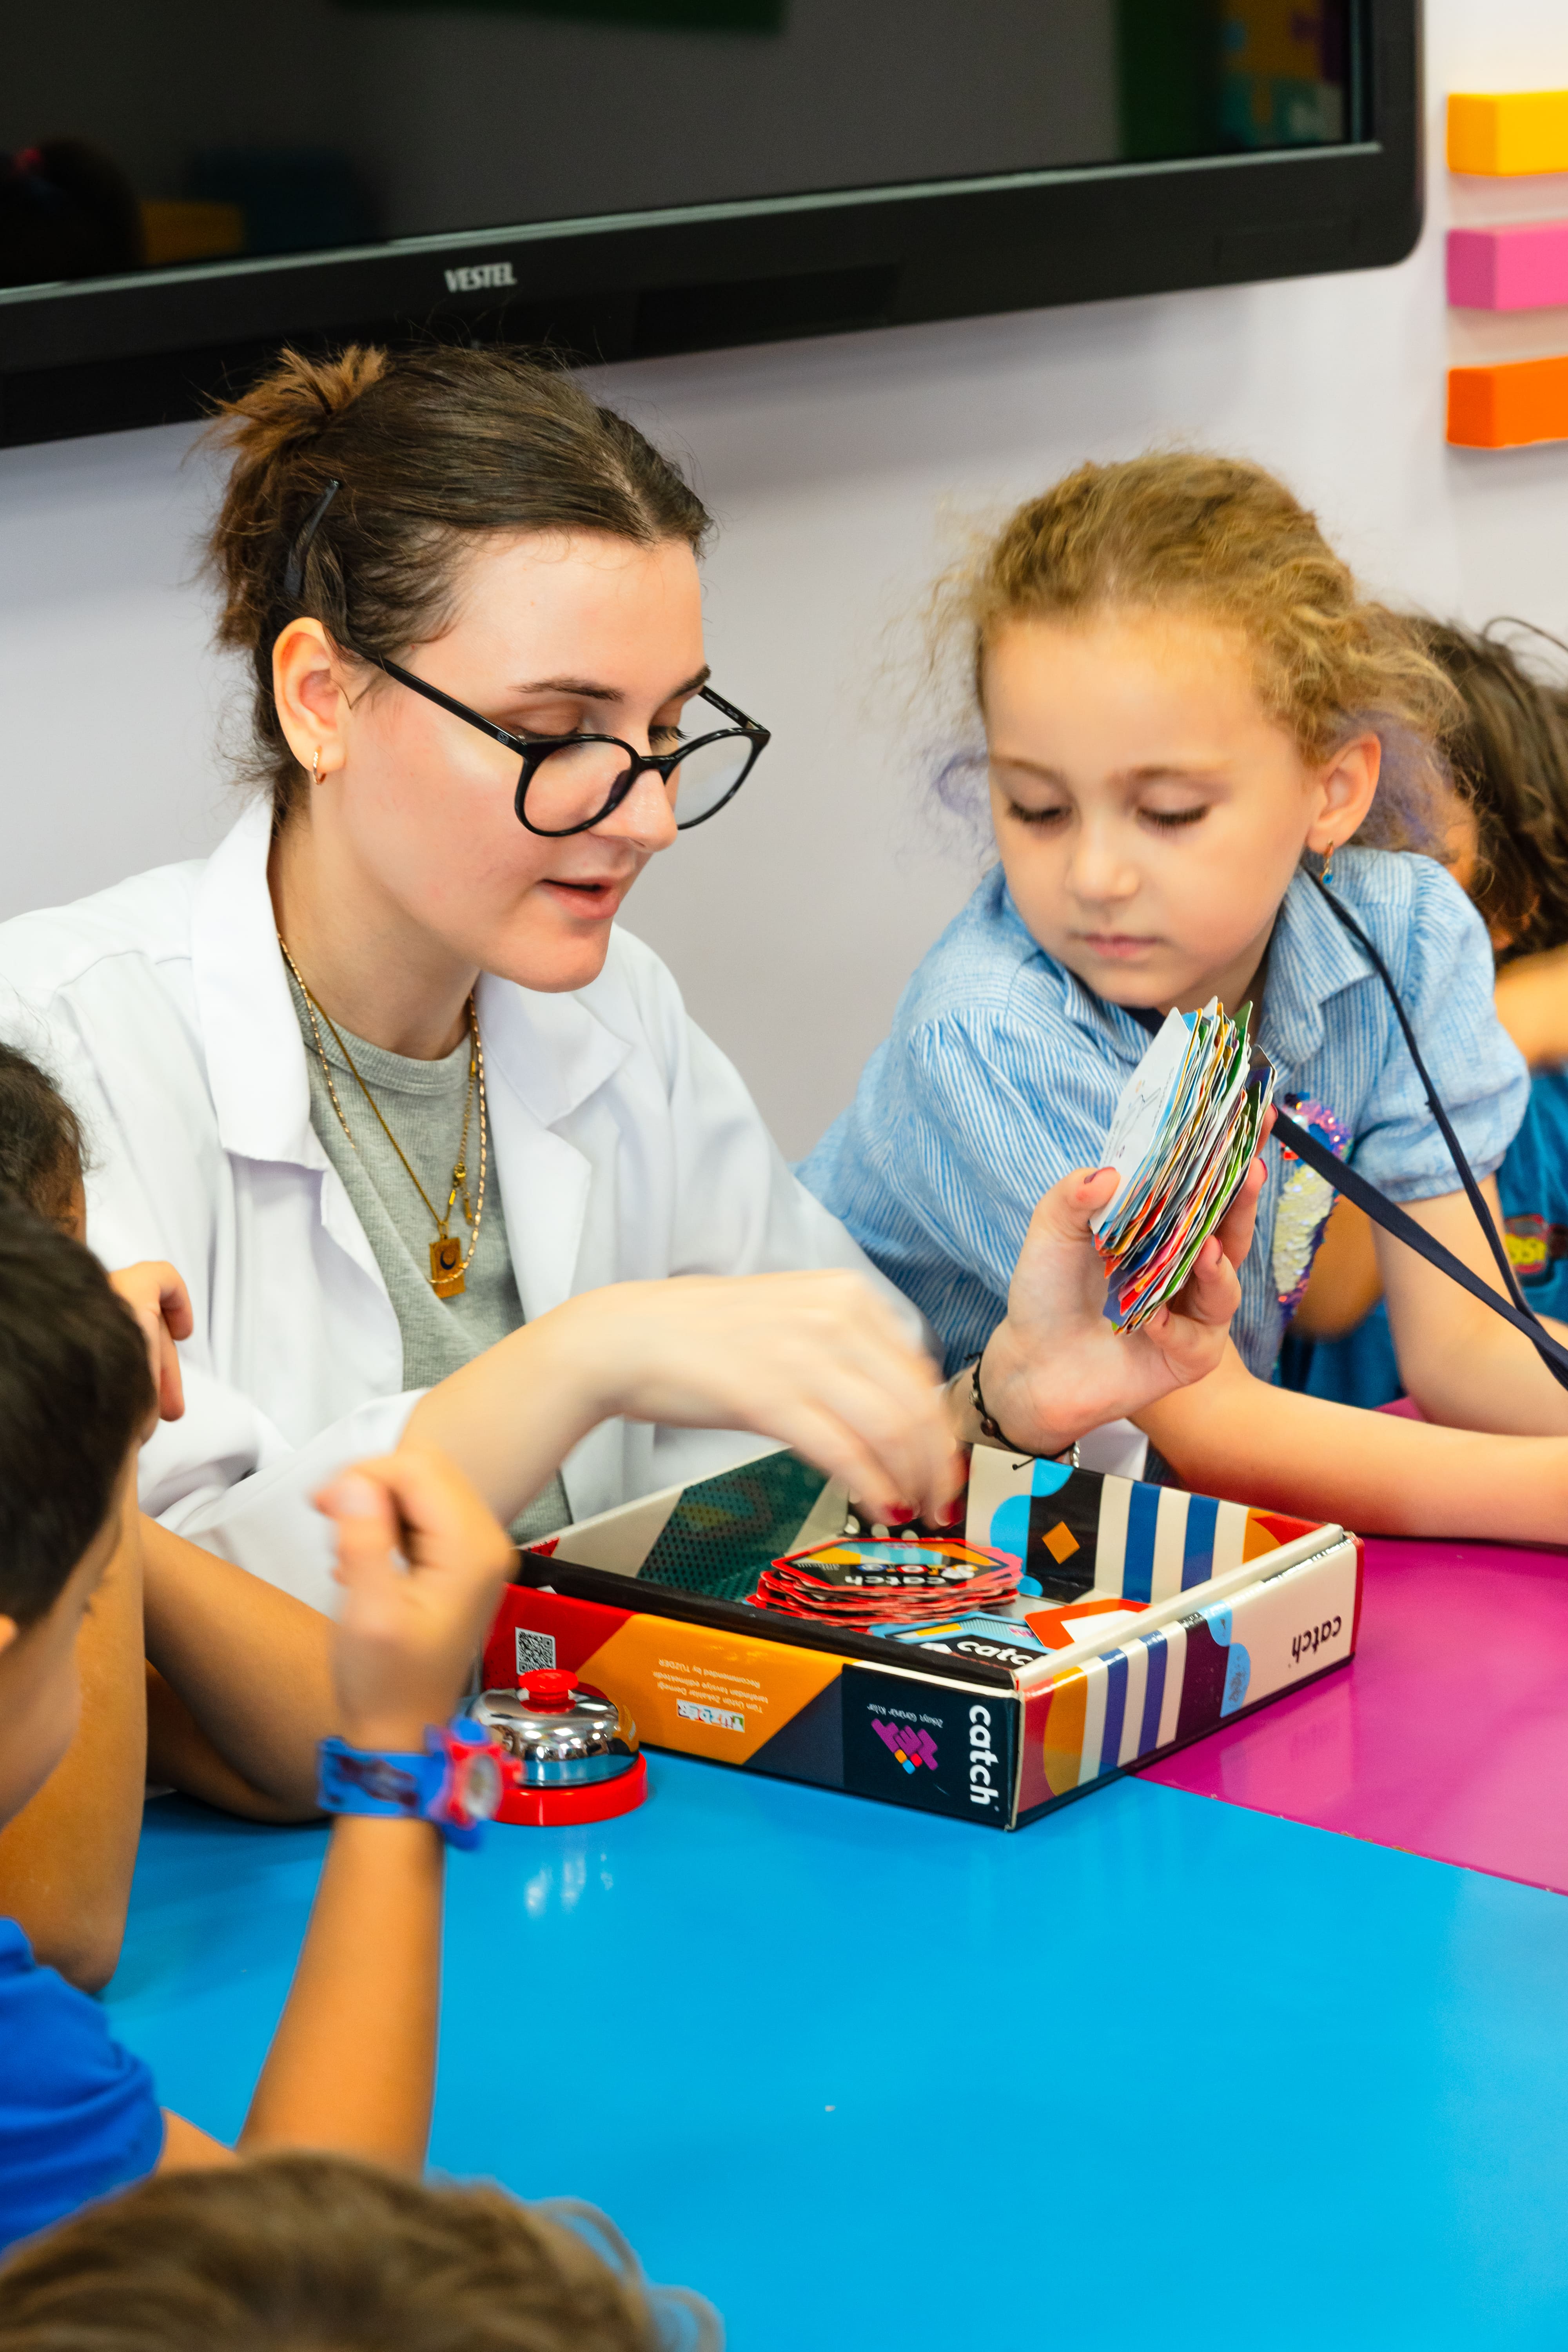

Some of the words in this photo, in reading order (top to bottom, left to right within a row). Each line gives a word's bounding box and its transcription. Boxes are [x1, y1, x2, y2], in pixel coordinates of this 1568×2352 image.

[445, 261, 517, 293] VESTEL
[844, 1575, 946, 1586] catch
[1292, 1615, 1341, 1664] catch
[956, 1641, 1034, 1666] catc
[692, 1665, 702, 1675] by
[703, 1668, 760, 1689] Recommended
[969, 1705, 999, 1805] catch
